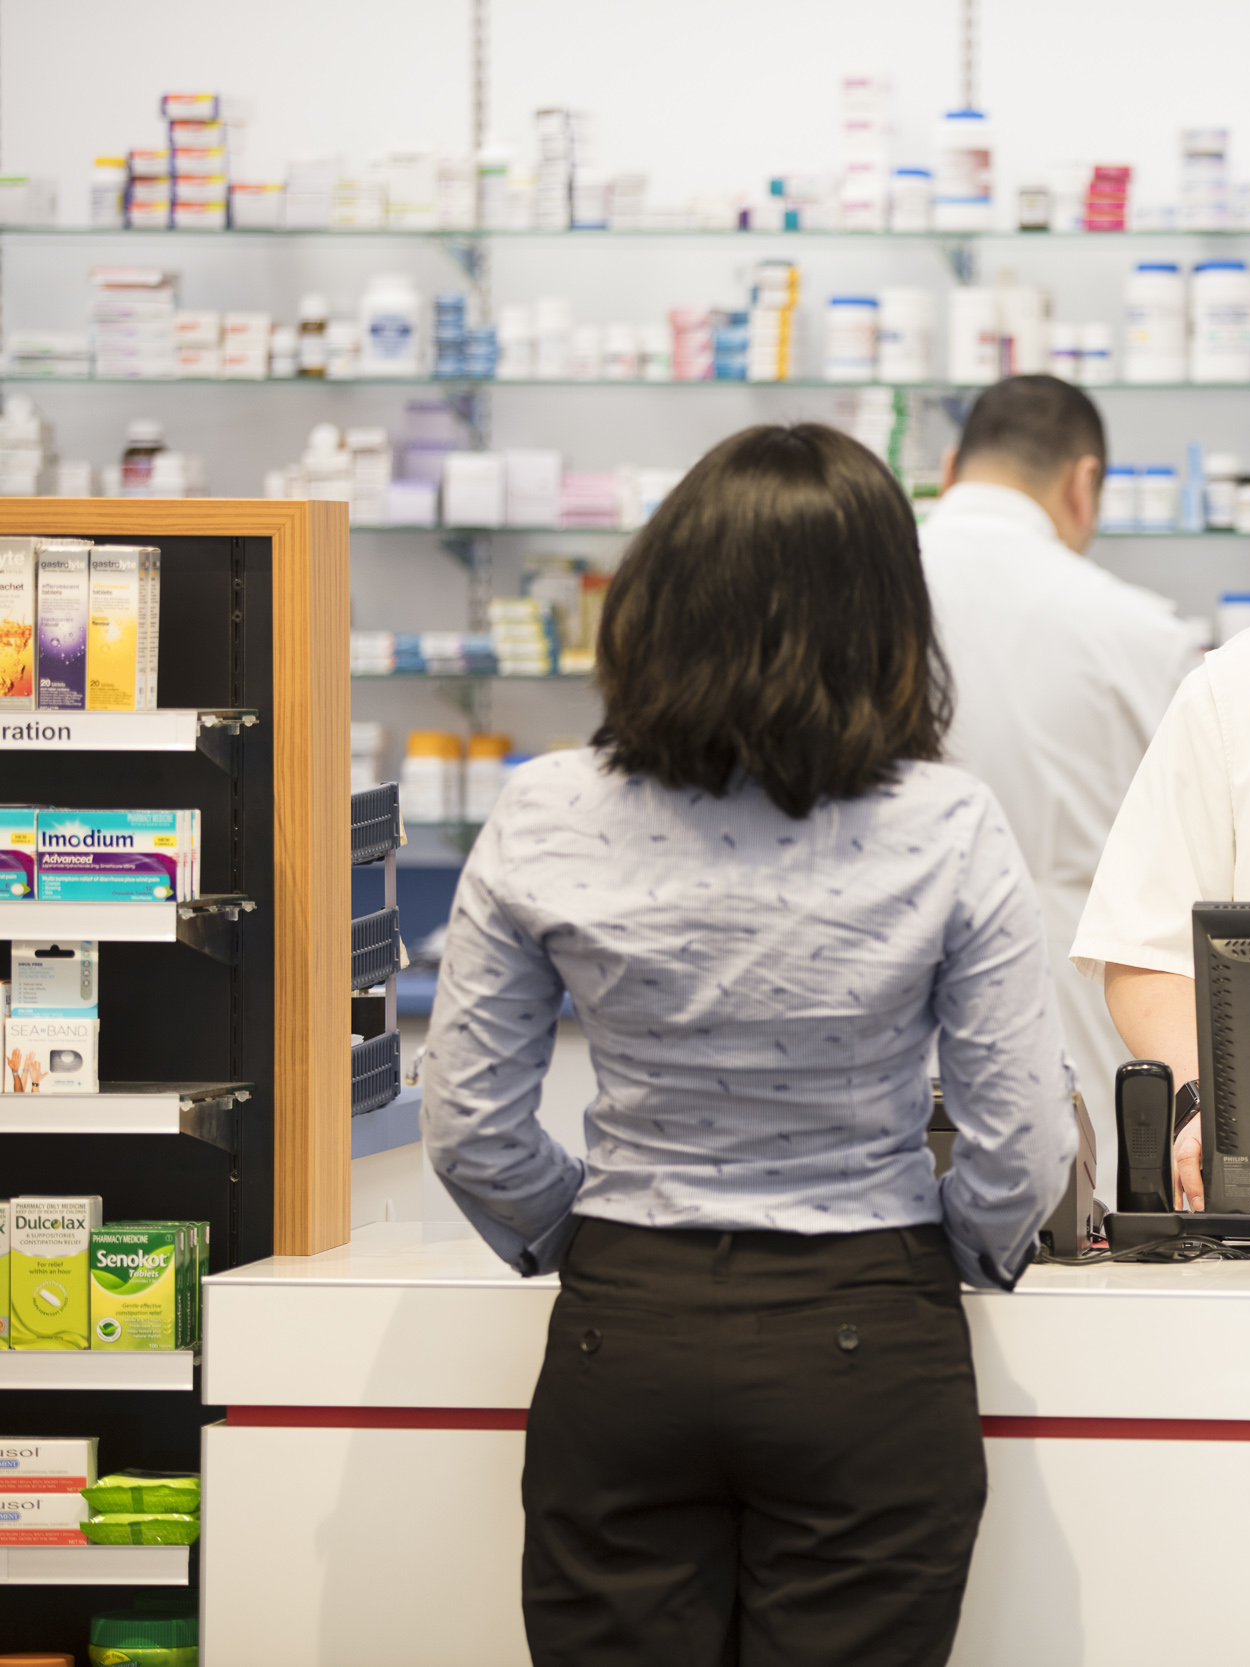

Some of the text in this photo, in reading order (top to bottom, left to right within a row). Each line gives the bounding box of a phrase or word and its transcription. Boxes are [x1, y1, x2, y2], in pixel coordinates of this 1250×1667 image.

[41, 560, 86, 570] gastrolyte
[92, 560, 136, 570] gastrolyte
[40, 679, 50, 688] 20
[2, 722, 71, 740] ration
[127, 814, 173, 823] PHARMACY MEDICINE
[42, 829, 134, 848] Imodium
[42, 854, 93, 864] Advanced
[16, 1216, 85, 1229] Dulcolax
[93, 1235, 148, 1243] PHARMACY MEDICINE
[97, 1249, 167, 1268] Senokot
[129, 1269, 158, 1278] Tablets
